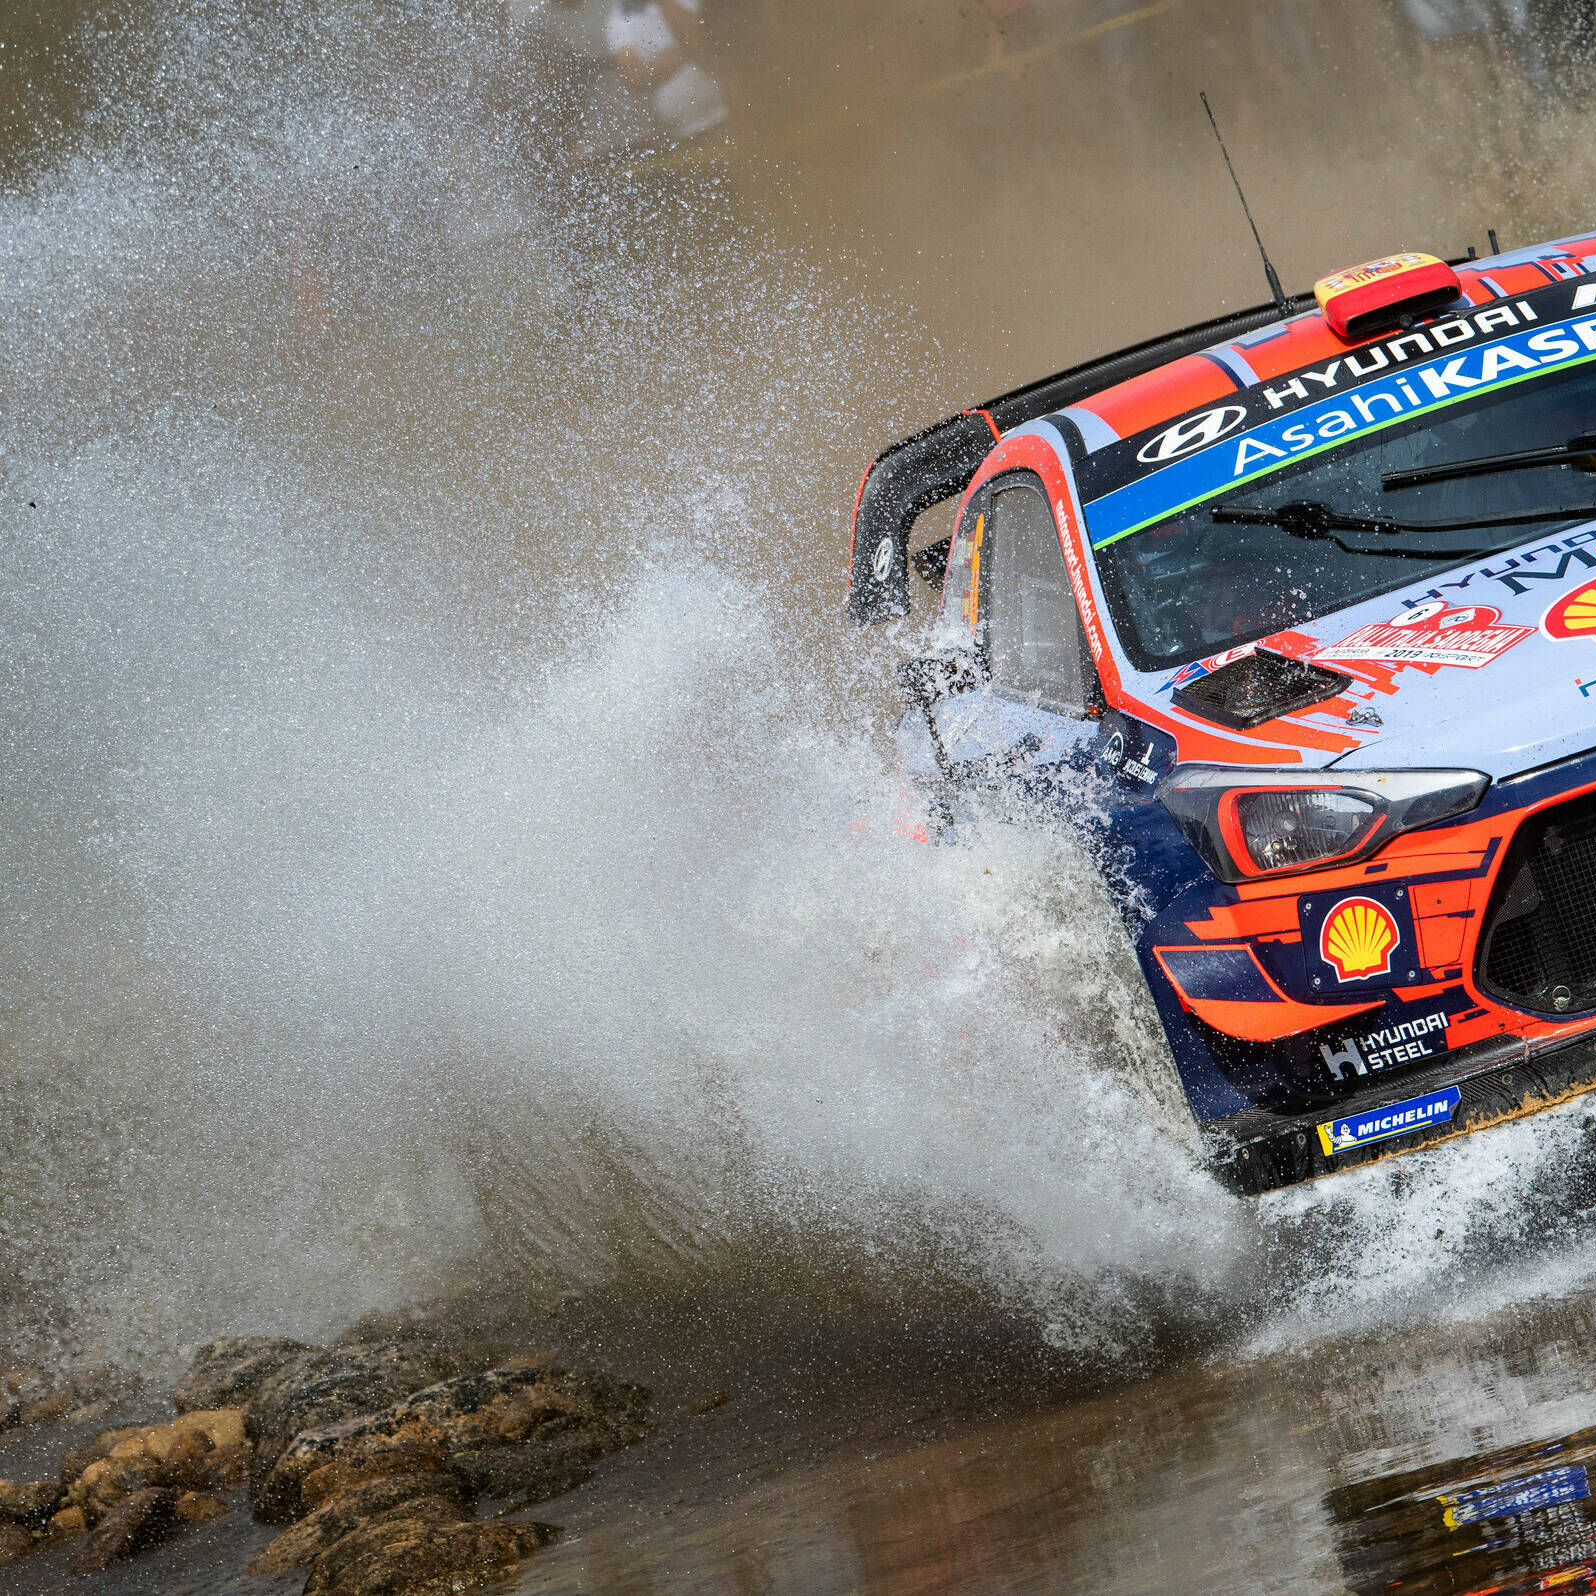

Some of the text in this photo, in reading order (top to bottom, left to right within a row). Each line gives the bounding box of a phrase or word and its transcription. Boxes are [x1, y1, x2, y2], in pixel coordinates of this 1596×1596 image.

[1263, 302, 1537, 409] HYUNDAI
[1055, 498, 1104, 663] motorsport.hyundai.com
[1334, 625, 1518, 654] RALLY ITALIA SARDEGNA
[1384, 649, 1423, 658] 2019
[1361, 1012, 1449, 1050] HYUNDAI
[1368, 1041, 1432, 1070] STEEL
[1358, 1099, 1448, 1136] MICHELIN
